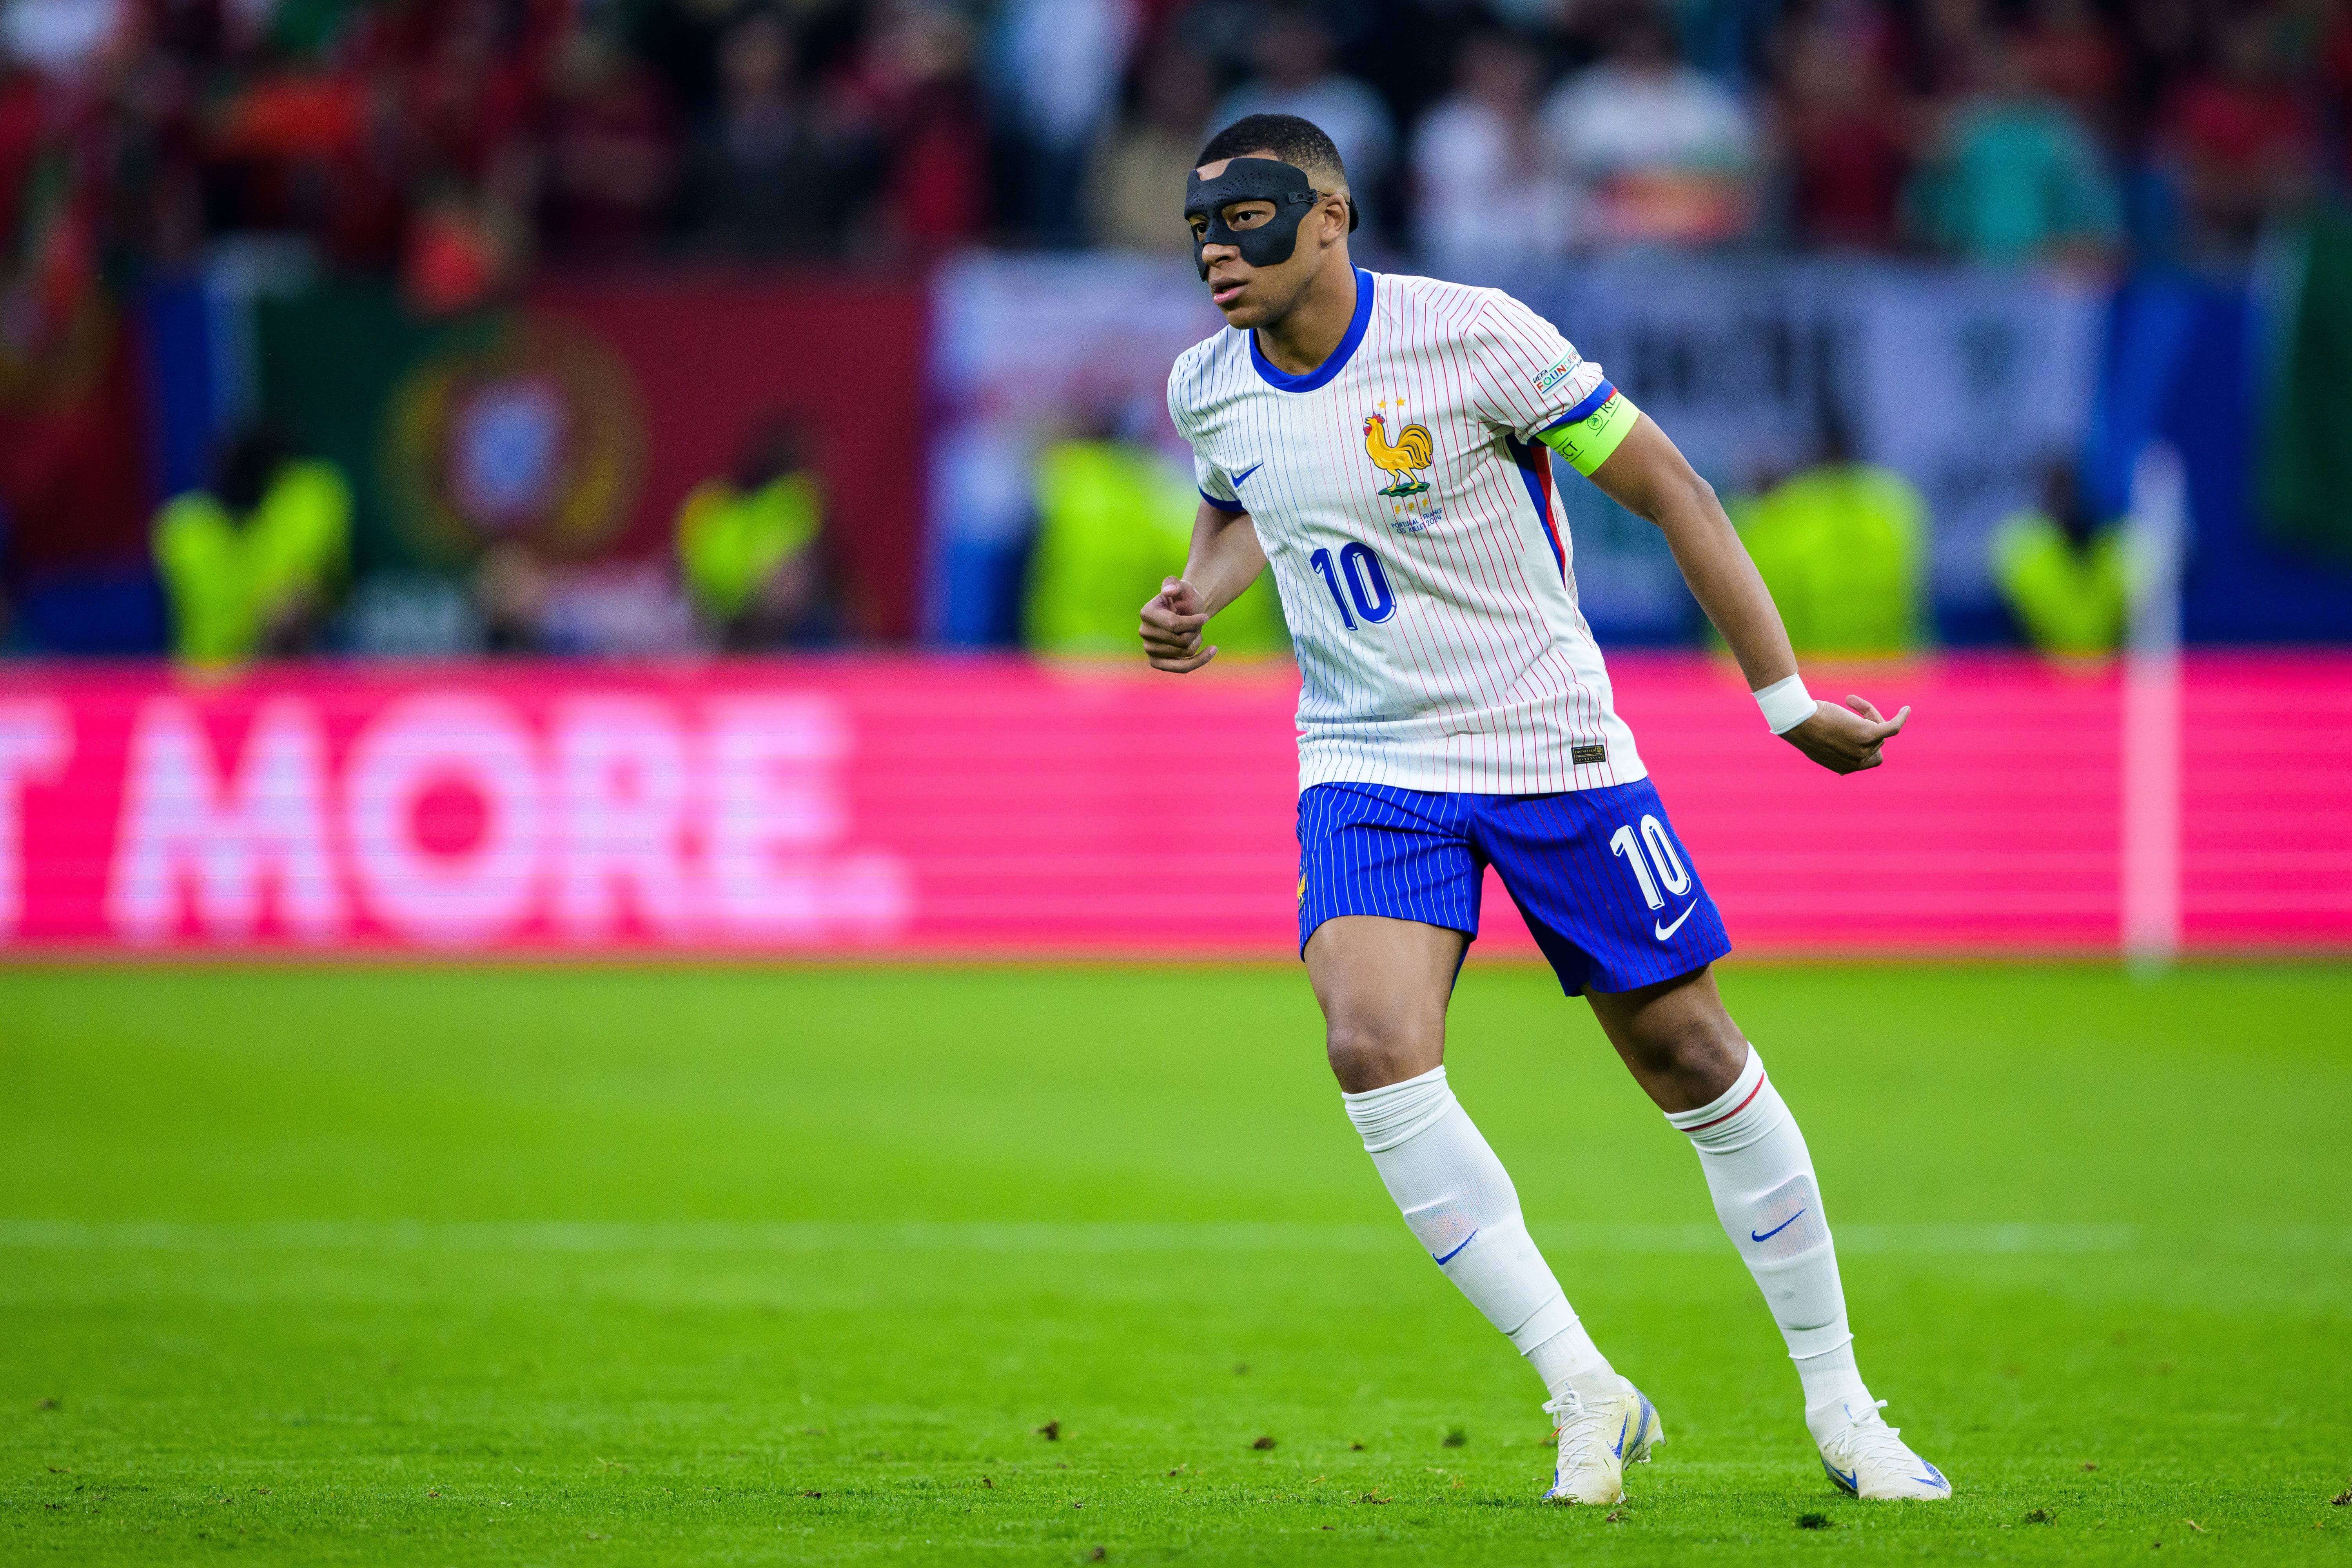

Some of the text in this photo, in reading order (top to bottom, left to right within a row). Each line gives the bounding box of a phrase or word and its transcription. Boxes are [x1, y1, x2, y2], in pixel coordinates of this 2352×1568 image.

[1533, 369, 1548, 383] UEFA
[1536, 348, 1578, 391] FOUNDATION
[1391, 517, 1419, 528] PORTUGAL
[1423, 508, 1443, 520] FRANCE
[1426, 515, 1442, 526] 2024
[1310, 542, 1397, 631] 10
[108, 691, 914, 947] MORE.
[1610, 814, 1691, 910] 10
